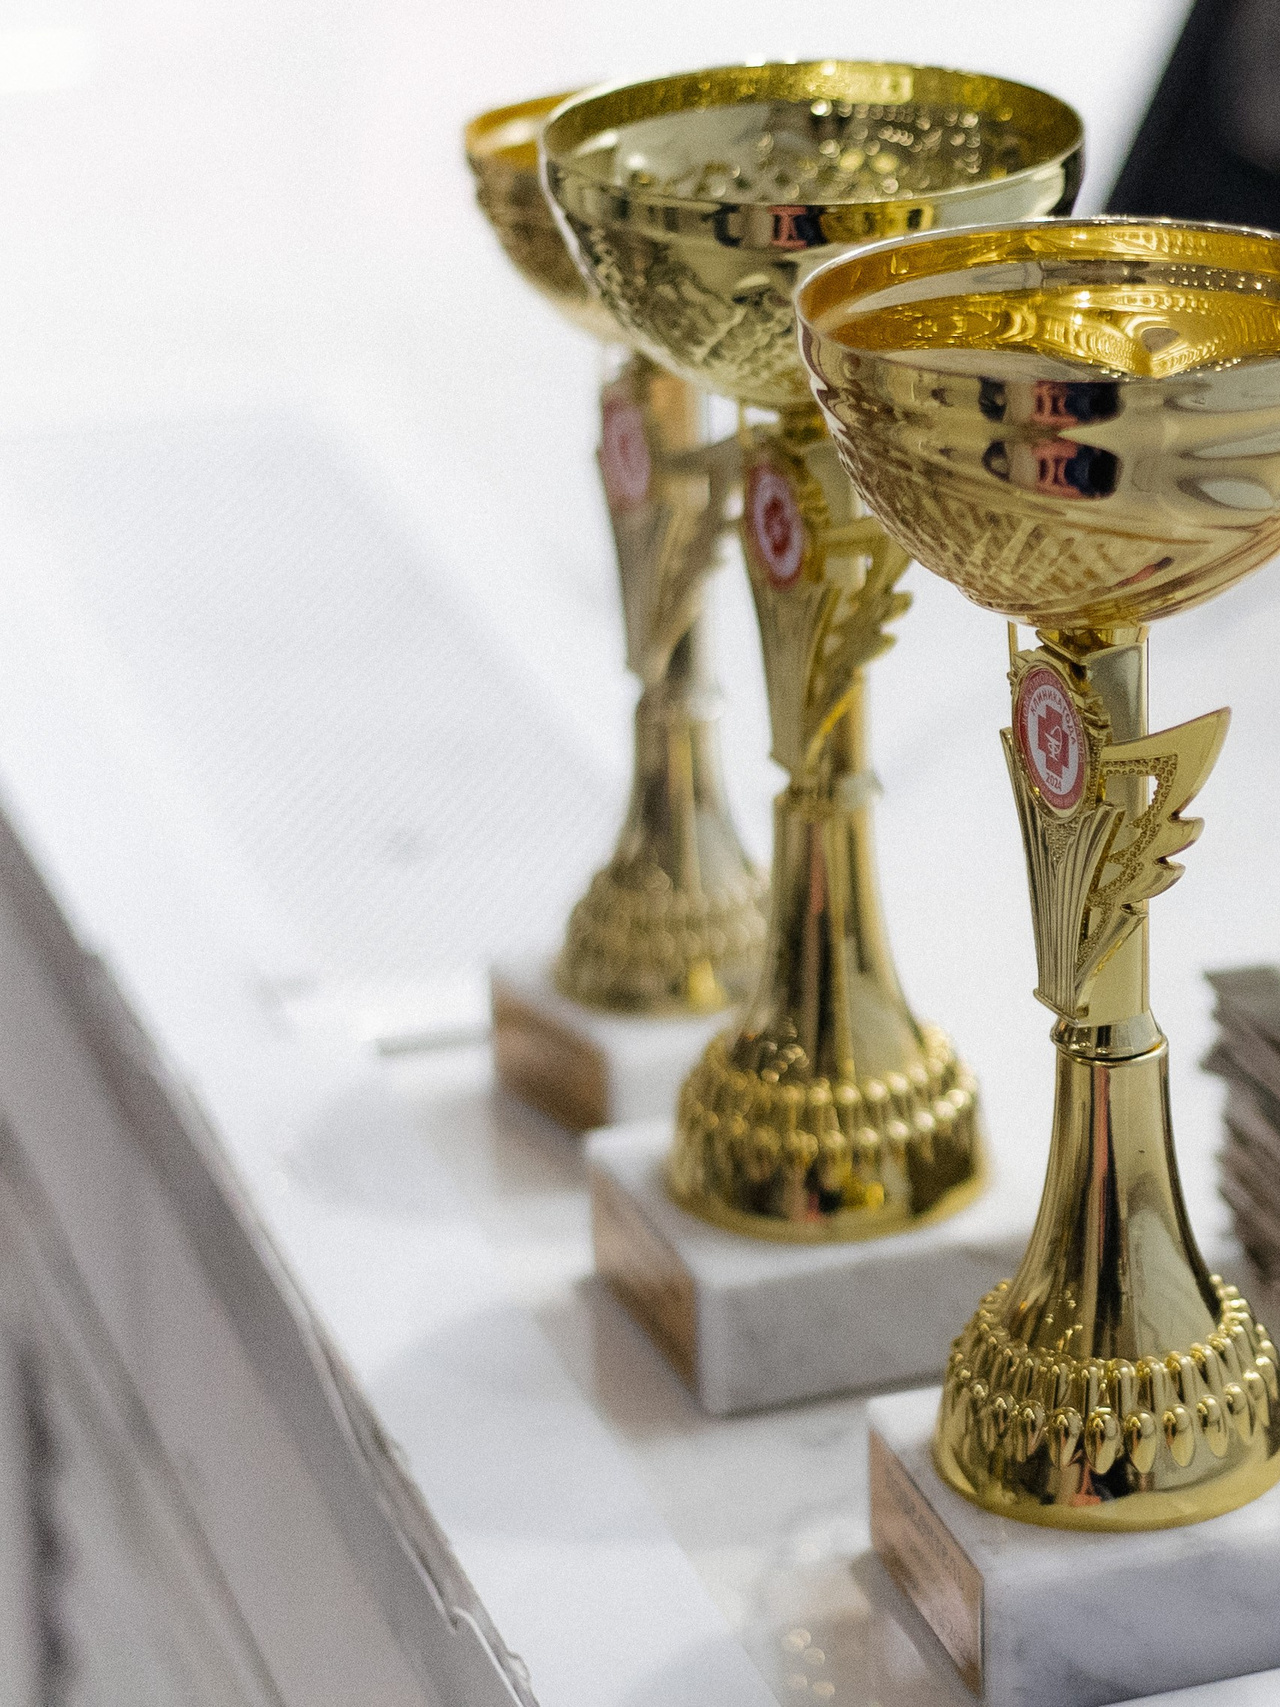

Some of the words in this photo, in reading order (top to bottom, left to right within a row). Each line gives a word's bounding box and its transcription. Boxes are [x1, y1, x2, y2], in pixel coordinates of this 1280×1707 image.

[1030, 689, 1062, 716] КЛИНИКА
[1061, 705, 1077, 745] ГОДА
[1045, 771, 1062, 792] 2024
